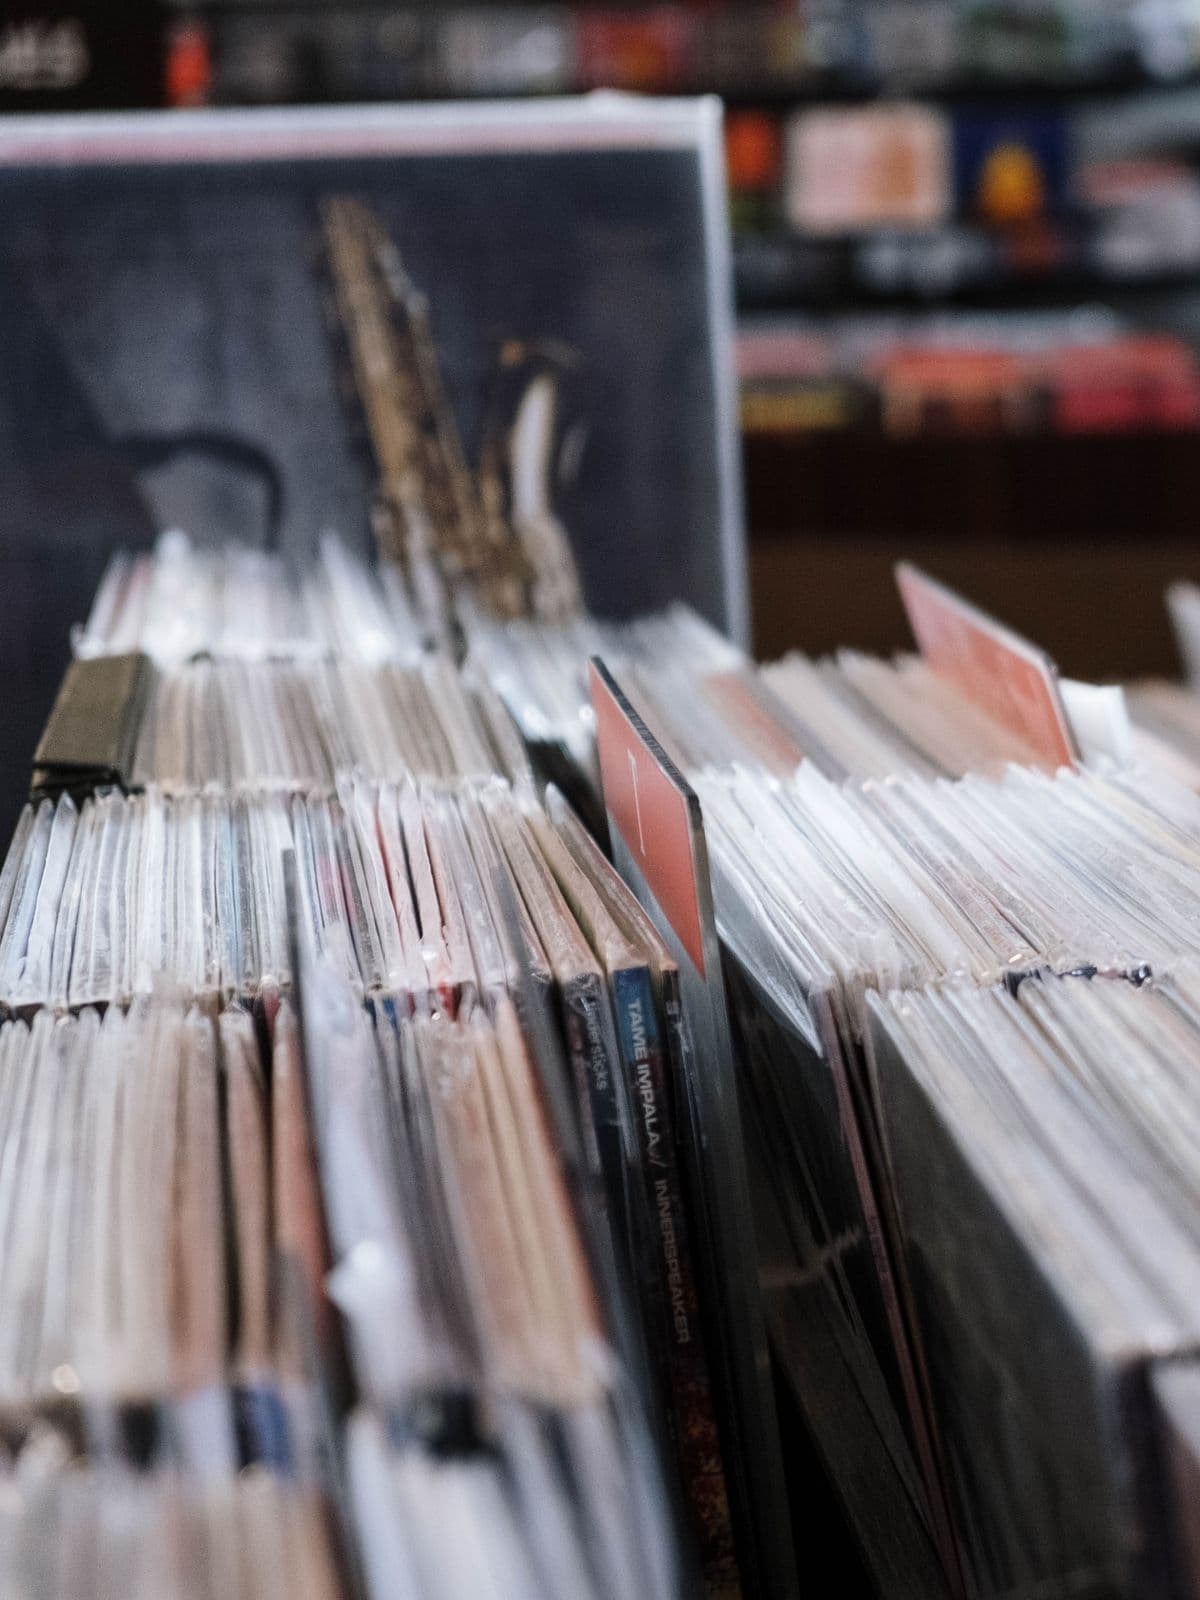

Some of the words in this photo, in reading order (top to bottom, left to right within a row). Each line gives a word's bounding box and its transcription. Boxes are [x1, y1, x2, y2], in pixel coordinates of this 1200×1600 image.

[627, 998, 649, 1061] TAME
[637, 1062, 661, 1148] IMPALA
[655, 1178, 691, 1345] INNERSPEAKER
